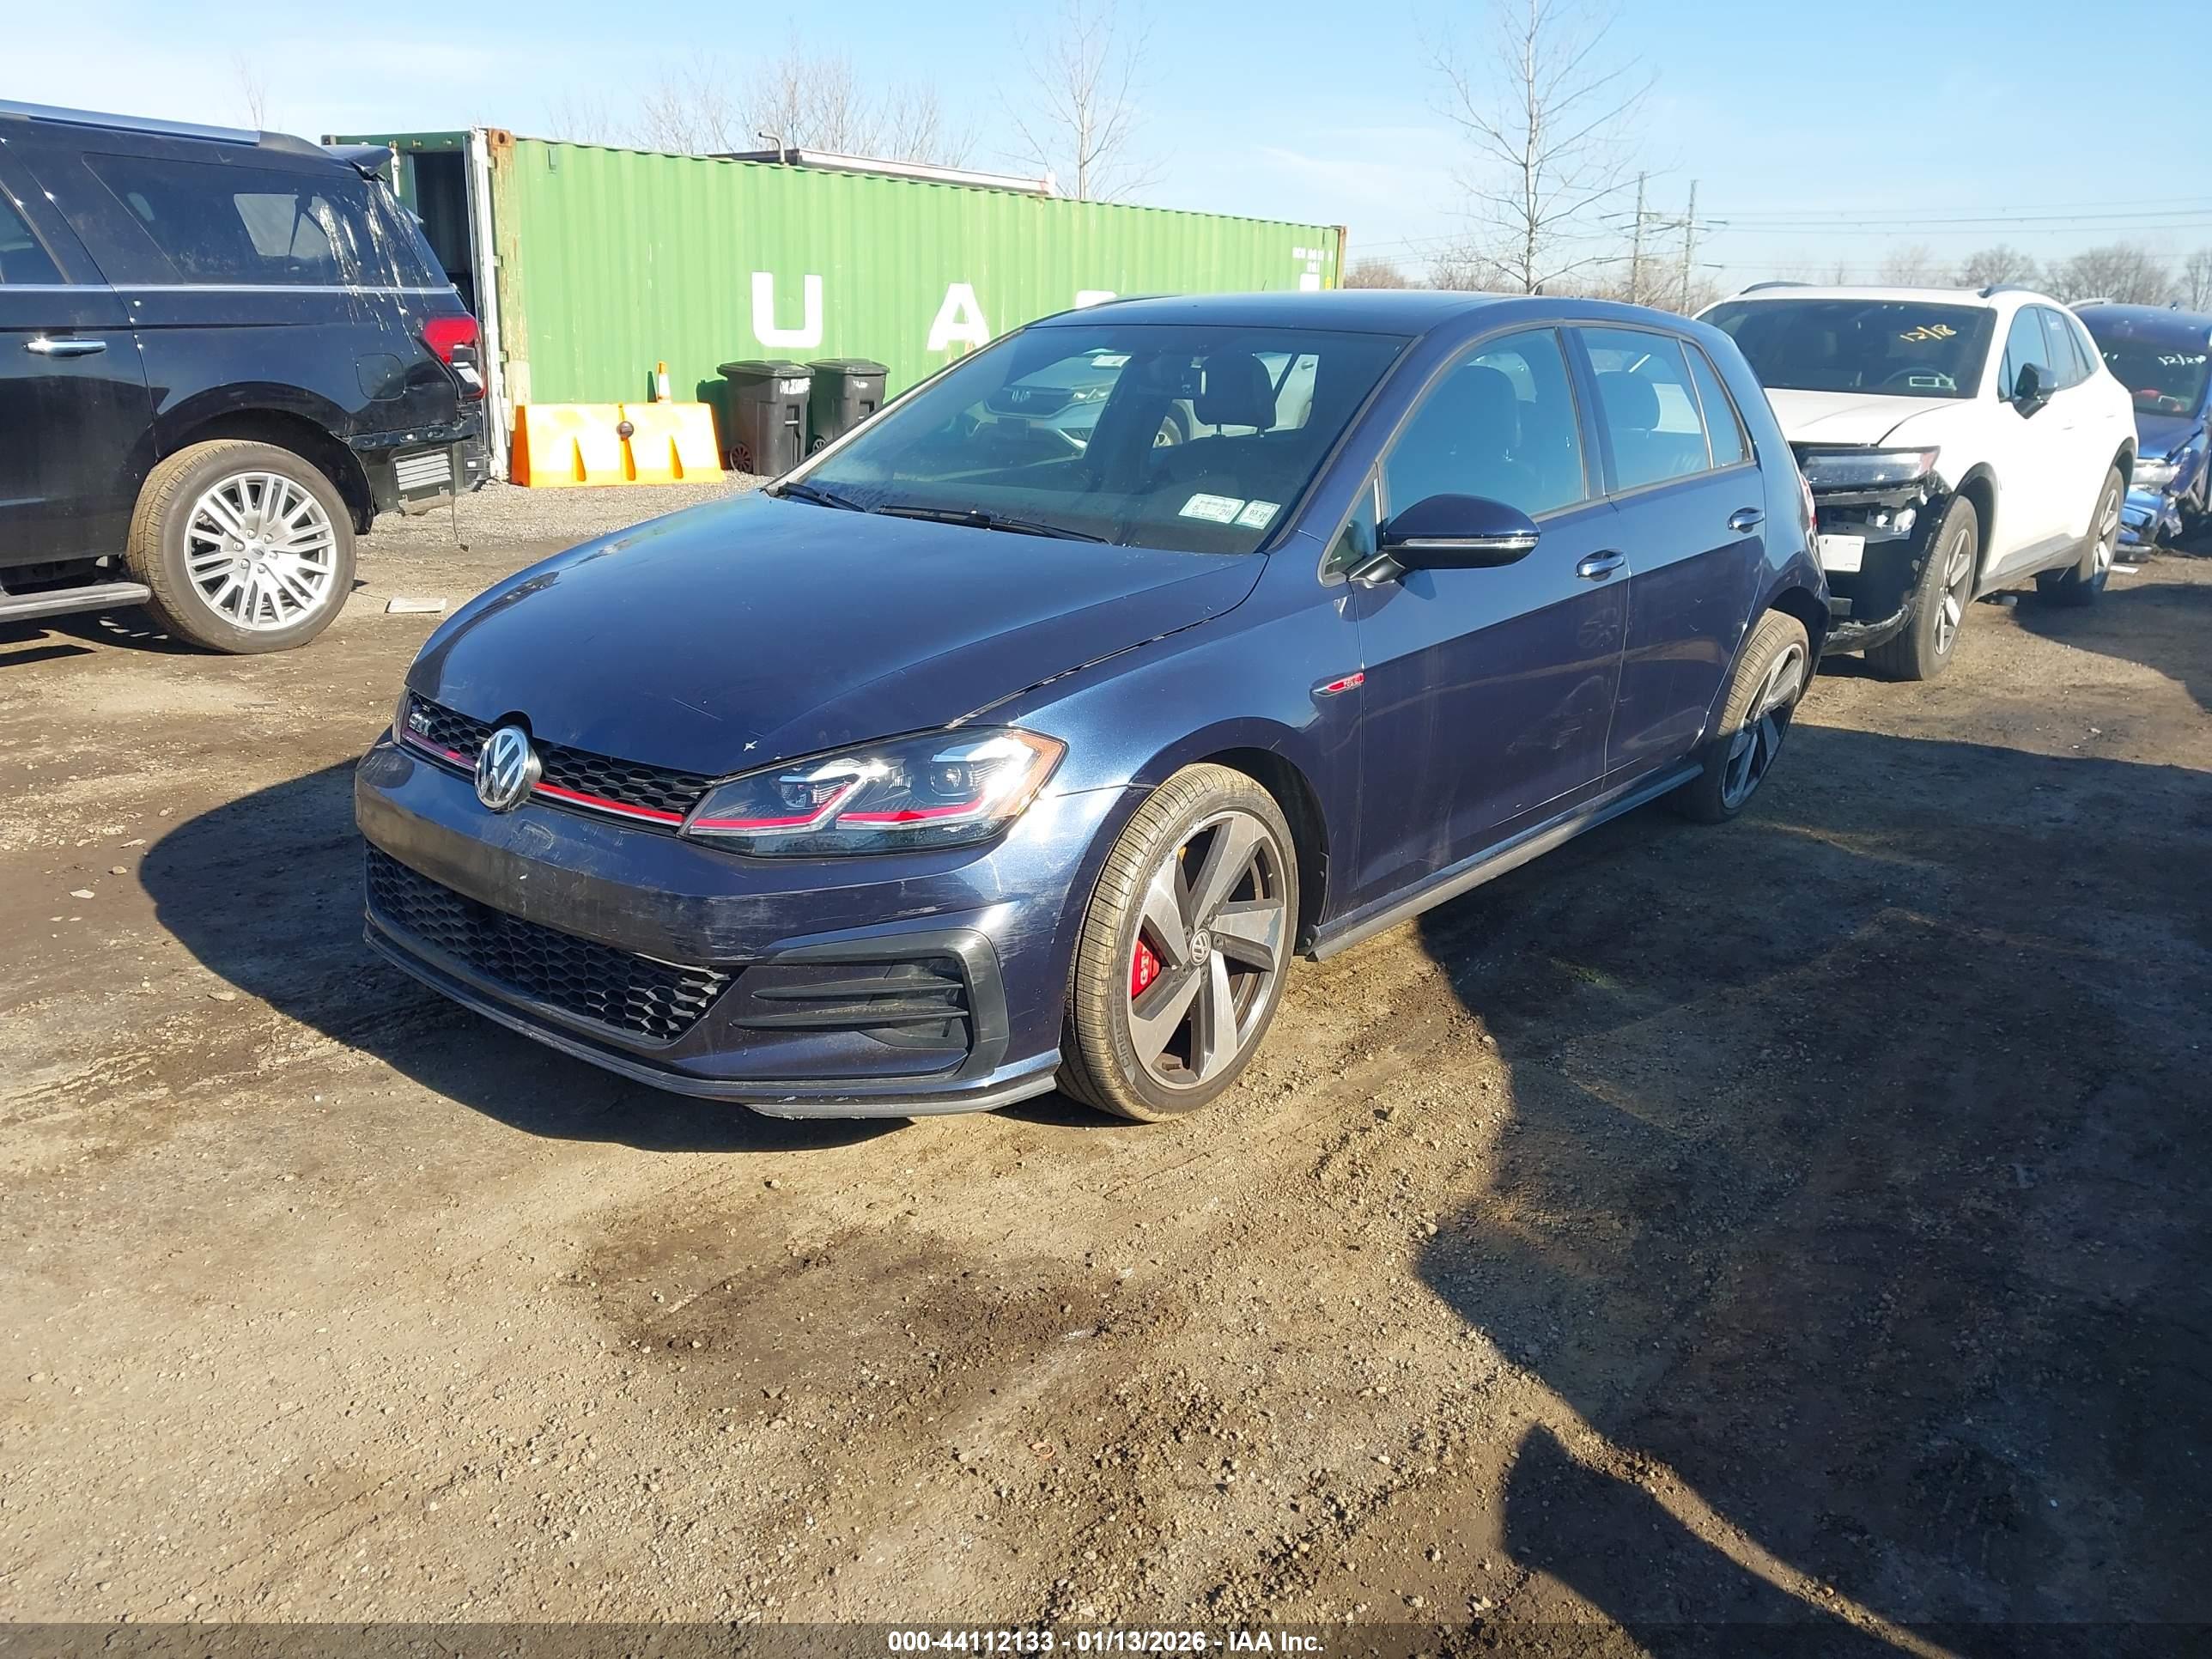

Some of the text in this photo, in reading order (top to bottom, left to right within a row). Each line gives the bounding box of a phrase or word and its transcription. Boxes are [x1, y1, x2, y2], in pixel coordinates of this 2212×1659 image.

[751, 271, 990, 350] U A
[1899, 324, 1957, 342] 12/18
